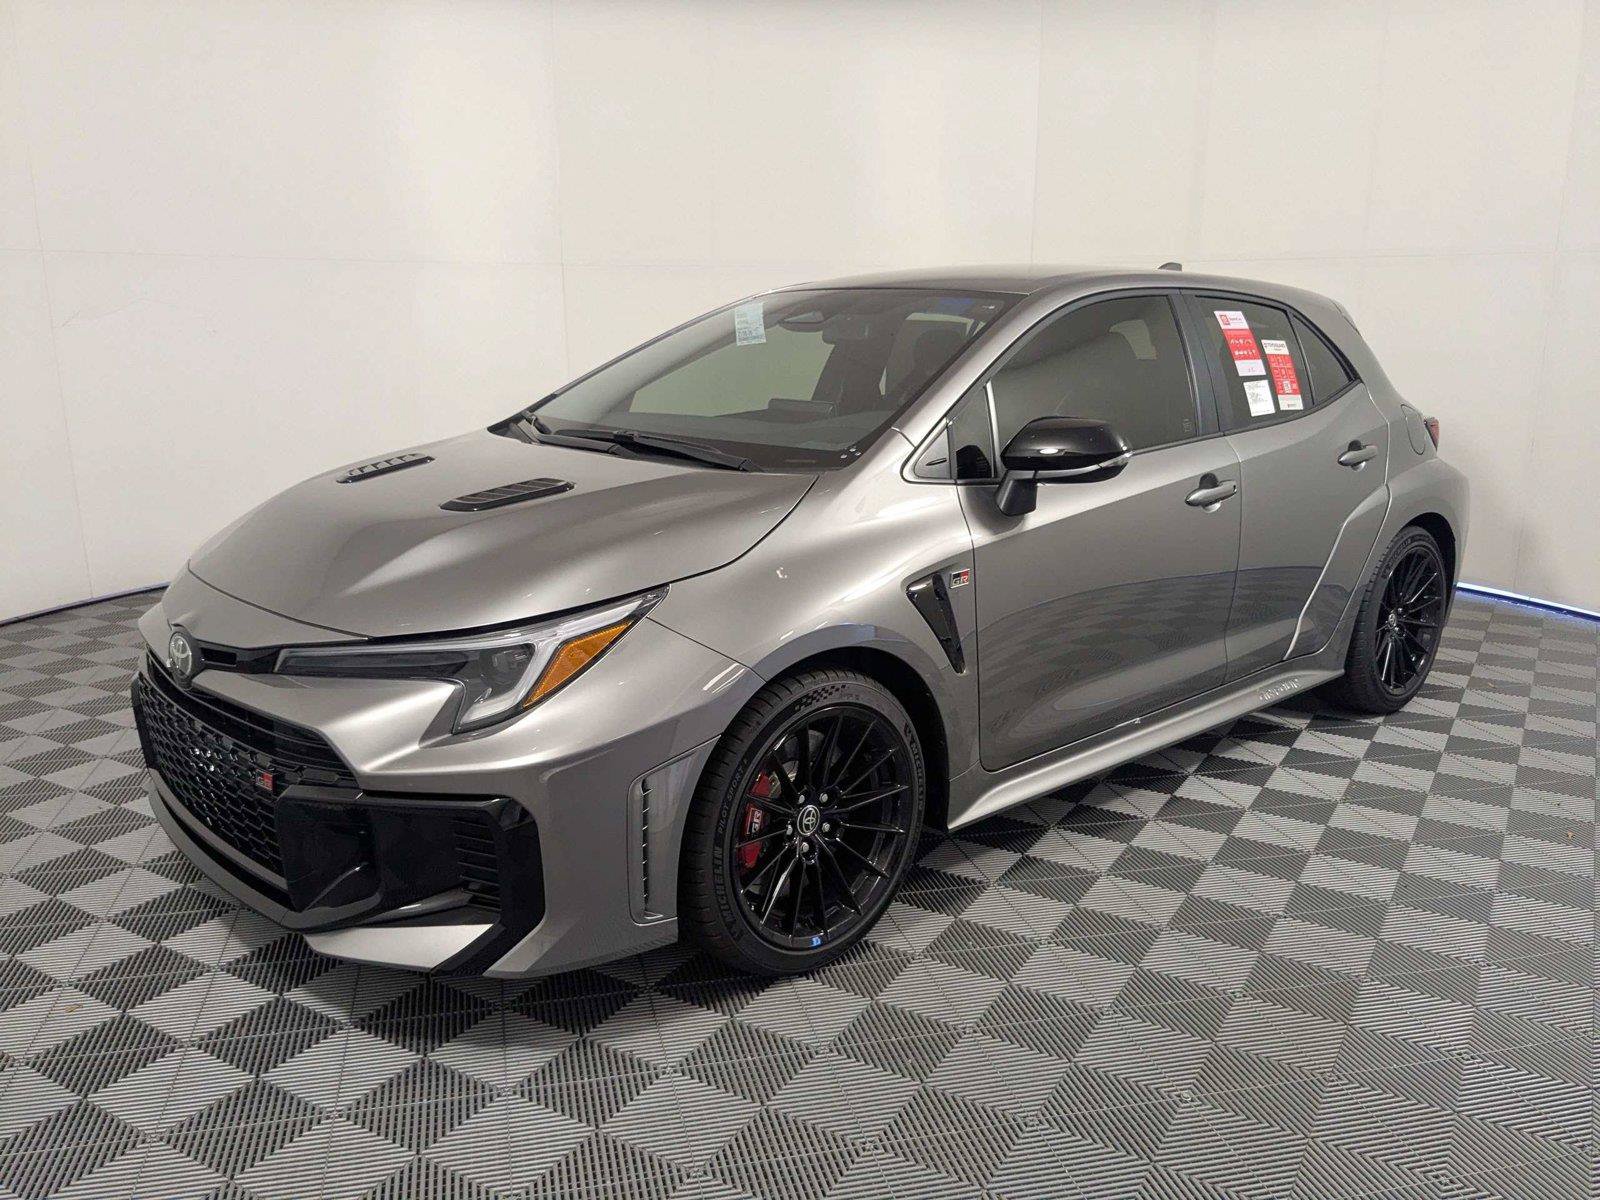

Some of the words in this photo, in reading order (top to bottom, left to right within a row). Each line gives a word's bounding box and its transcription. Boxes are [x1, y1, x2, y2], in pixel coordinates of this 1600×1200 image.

[951, 573, 970, 587] GR
[727, 765, 744, 801] SPORT
[717, 802, 729, 834] PILOT
[714, 846, 735, 922] MICHELIN
